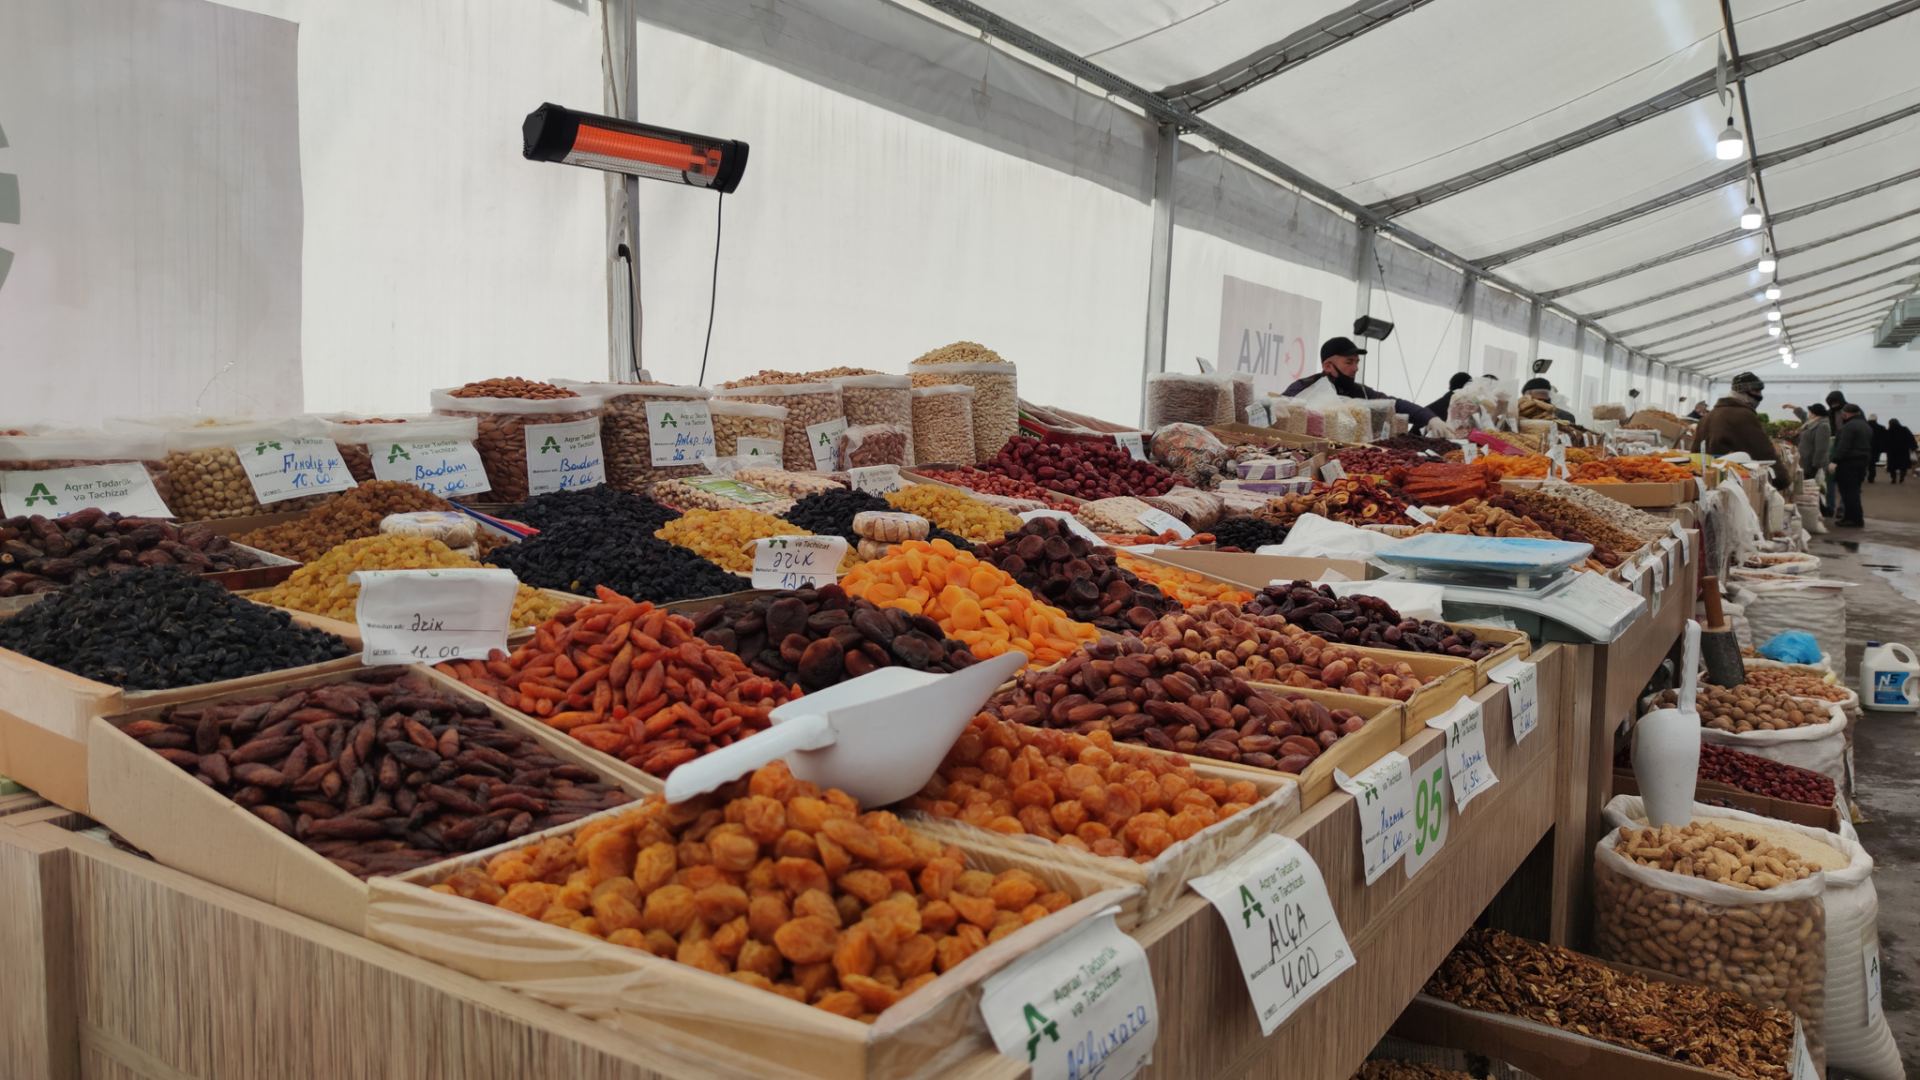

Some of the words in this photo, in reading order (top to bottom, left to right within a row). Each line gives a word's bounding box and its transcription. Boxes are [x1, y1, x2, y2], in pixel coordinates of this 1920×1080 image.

[415, 460, 467, 480] Badam
[64, 483, 93, 492] Aqrar
[73, 494, 86, 502] və
[89, 488, 129, 500] Təchizat
[1415, 766, 1443, 857] 95
[1259, 872, 1278, 891] Aqrar
[1278, 874, 1307, 898] Təchizat
[1053, 975, 1082, 1004] Aqrar
[1082, 966, 1123, 1006] Təchizat
